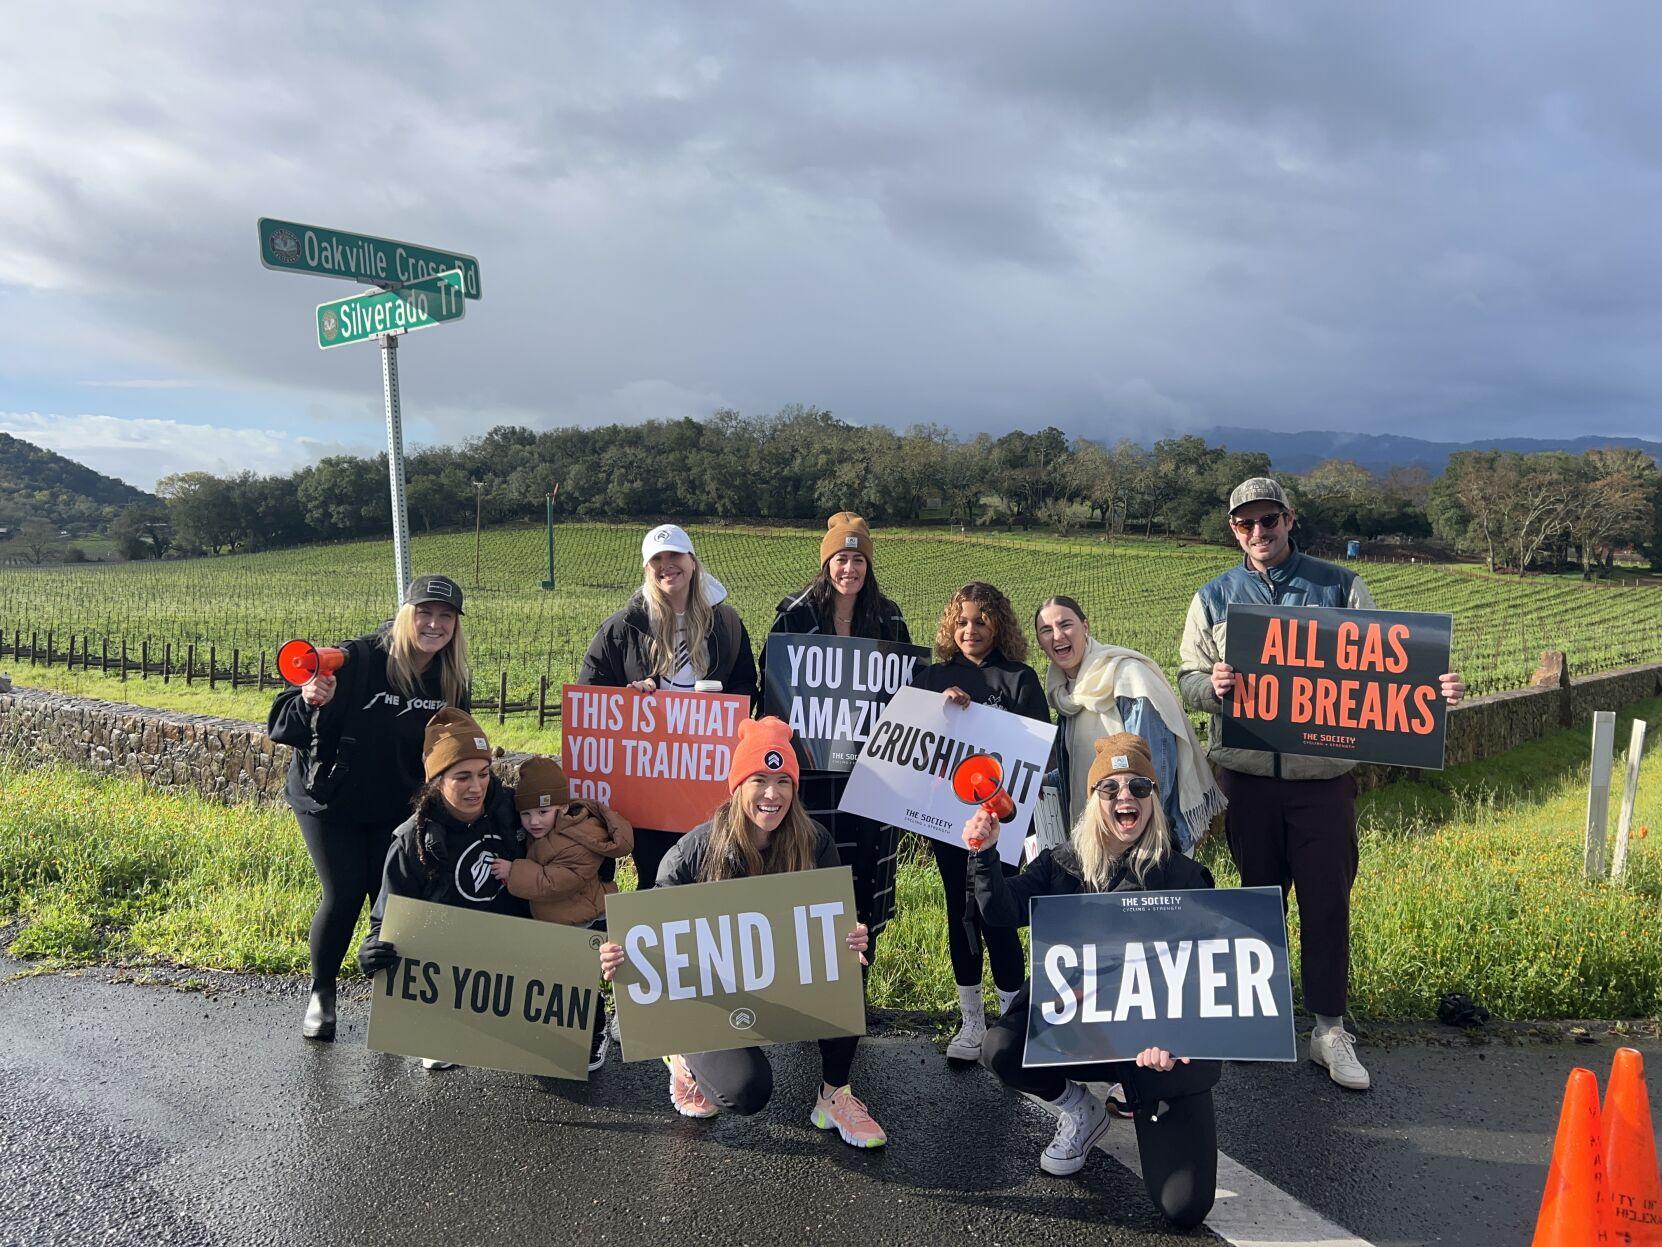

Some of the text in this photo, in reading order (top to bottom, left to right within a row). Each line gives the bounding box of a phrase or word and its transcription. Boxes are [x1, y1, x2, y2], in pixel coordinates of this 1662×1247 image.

[304, 230, 387, 278] Oakville
[340, 289, 428, 338] Silverado
[437, 280, 459, 315] Tr
[1260, 617, 1410, 674] ALL GAS
[787, 645, 917, 695] YOU LOOK
[362, 691, 400, 710] THE
[567, 691, 740, 737] THIS IS WHAT
[788, 695, 887, 743] AMAZI
[1233, 672, 1437, 735] NO BREAKS
[567, 735, 731, 782] YOU TRAINED
[1303, 732, 1356, 744] THE SOCIETY
[866, 720, 1041, 805] CRUSHI IT
[569, 777, 612, 807] FOR
[905, 808, 953, 830] THE SOCIETY
[1121, 896, 1182, 907] THE SOCIETY
[625, 901, 845, 1005] SEND IT
[384, 955, 592, 1031] YES YOU CAN
[1041, 937, 1279, 1026] SLAYER
